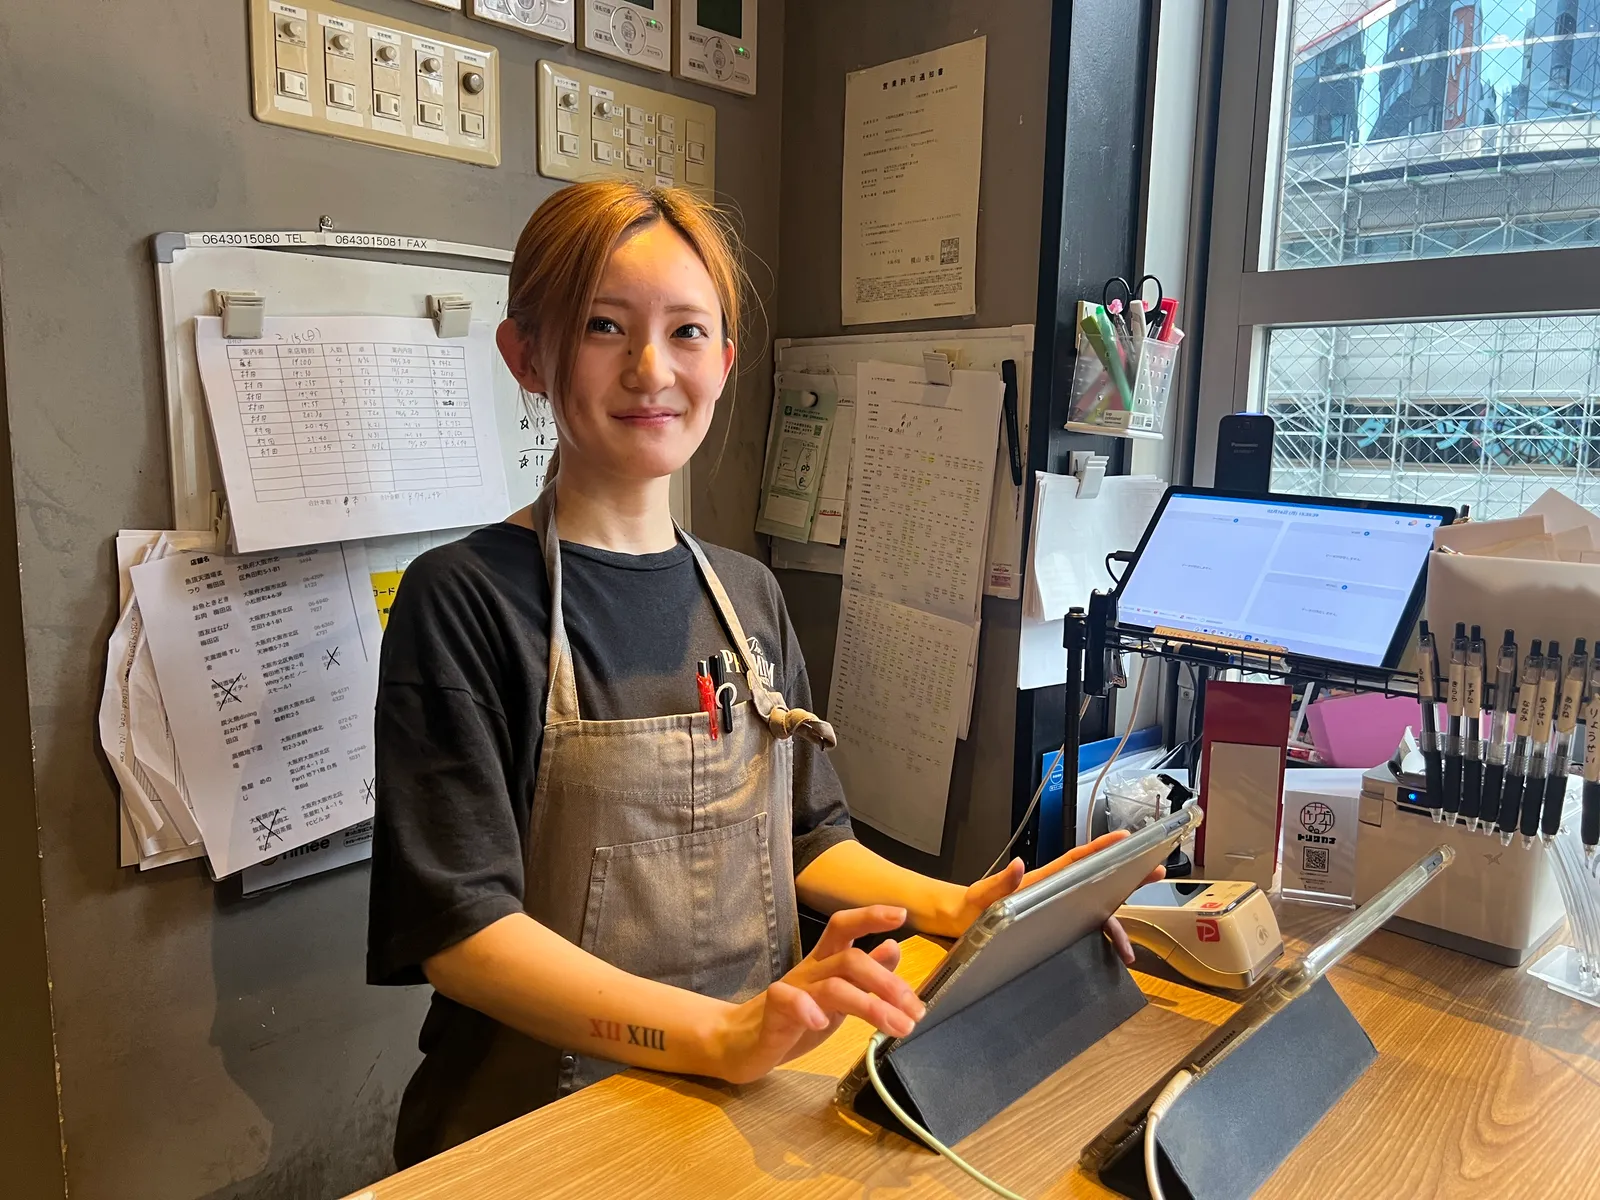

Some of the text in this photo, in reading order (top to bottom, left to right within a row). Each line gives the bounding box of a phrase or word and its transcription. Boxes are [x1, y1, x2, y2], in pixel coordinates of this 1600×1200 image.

[202, 234, 307, 244] 0643015080 TEL
[336, 235, 428, 249] 0643015081 FAX
[190, 556, 210, 566] 店舗名
[237, 556, 279, 571] 大阪府大阪市北
[207, 580, 225, 589] 梅田店
[244, 581, 287, 597] 大阪府大阪市北区
[193, 596, 228, 611] お魚ときどき
[213, 605, 232, 615] 梅田店
[249, 606, 293, 623] 大阪府大阪市北区
[198, 623, 229, 637] 酒友はなび
[200, 636, 219, 646] 梅田店
[255, 630, 299, 647] 大阪府大阪市北区
[261, 653, 305, 670] 大阪市北区角田町
[265, 673, 294, 686] Whityうめだ
[268, 683, 292, 694] スモール1
[273, 696, 315, 714] 大阪府大阪市北区
[224, 722, 248, 735] おかげ家
[281, 725, 324, 743] 大阪府高槻市城北
[226, 736, 238, 745] 田店
[232, 744, 263, 759] 高槻地下酒
[287, 747, 330, 767] 大阪府大阪市北区
[242, 783, 254, 792] 魚屋
[301, 791, 343, 811] 大阪府大阪市北区
[306, 817, 324, 827] FCビル
[627, 1024, 666, 1051] XIII
